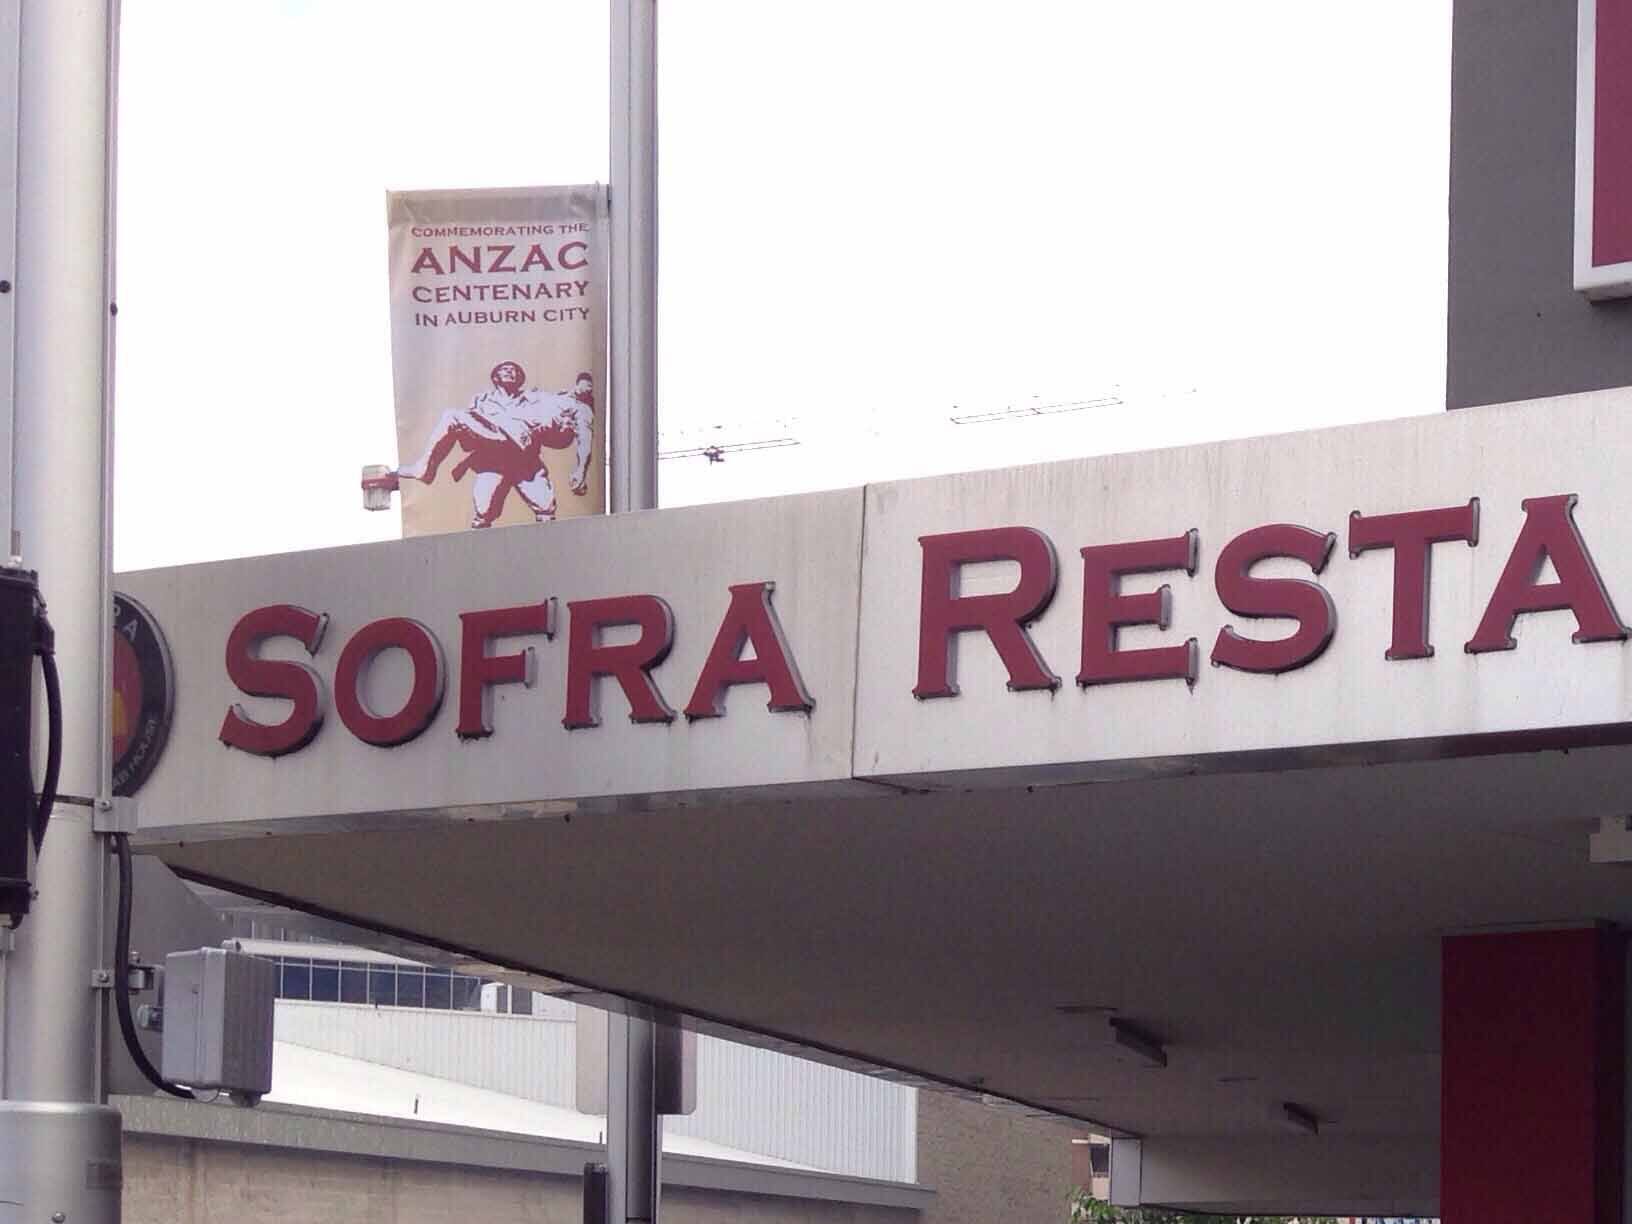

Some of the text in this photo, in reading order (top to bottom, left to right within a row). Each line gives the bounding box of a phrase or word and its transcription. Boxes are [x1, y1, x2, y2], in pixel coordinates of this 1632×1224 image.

[411, 223, 590, 238] COMMEMORATING THE
[411, 241, 589, 275] ANZAC
[412, 281, 589, 303] CENTENARY
[415, 307, 590, 327] IN AUBURN CITY
[219, 581, 815, 757] SOFRA
